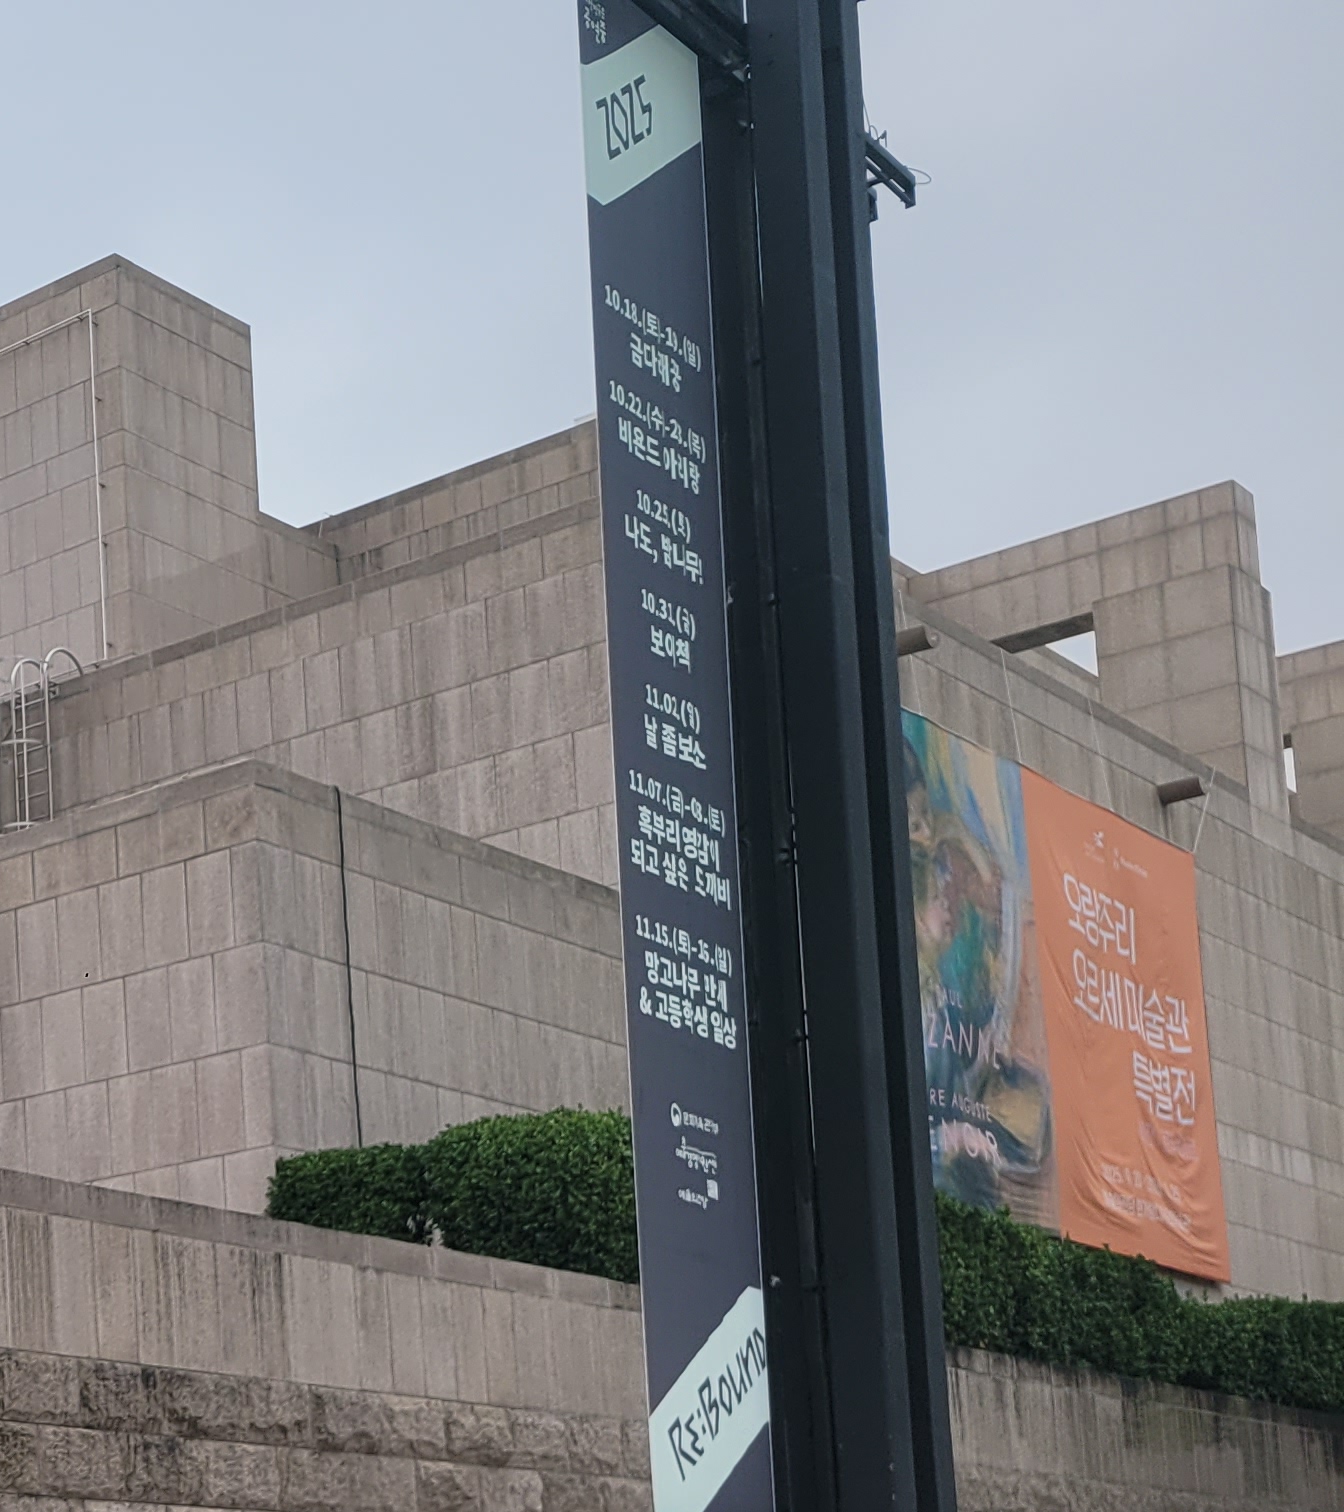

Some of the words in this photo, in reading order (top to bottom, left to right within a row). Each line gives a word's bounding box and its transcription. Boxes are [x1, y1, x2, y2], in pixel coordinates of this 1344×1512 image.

[595, 74, 653, 161] 2025
[617, 416, 662, 467] 비욘드
[662, 446, 701, 495] 아리랑
[631, 838, 660, 876] 되고
[662, 851, 689, 892] 싶은
[694, 864, 732, 911] 도깨비
[637, 804, 681, 853] 혹부리
[681, 826, 720, 873] 영감이
[1063, 872, 1136, 965] 오랑주리
[639, 985, 652, 1016] &
[655, 990, 709, 1038] 고등학생
[710, 1010, 737, 1049] 일상
[644, 950, 701, 999] 망고나무
[703, 973, 728, 1014] 만세
[1132, 1050, 1195, 1126] 특별전
